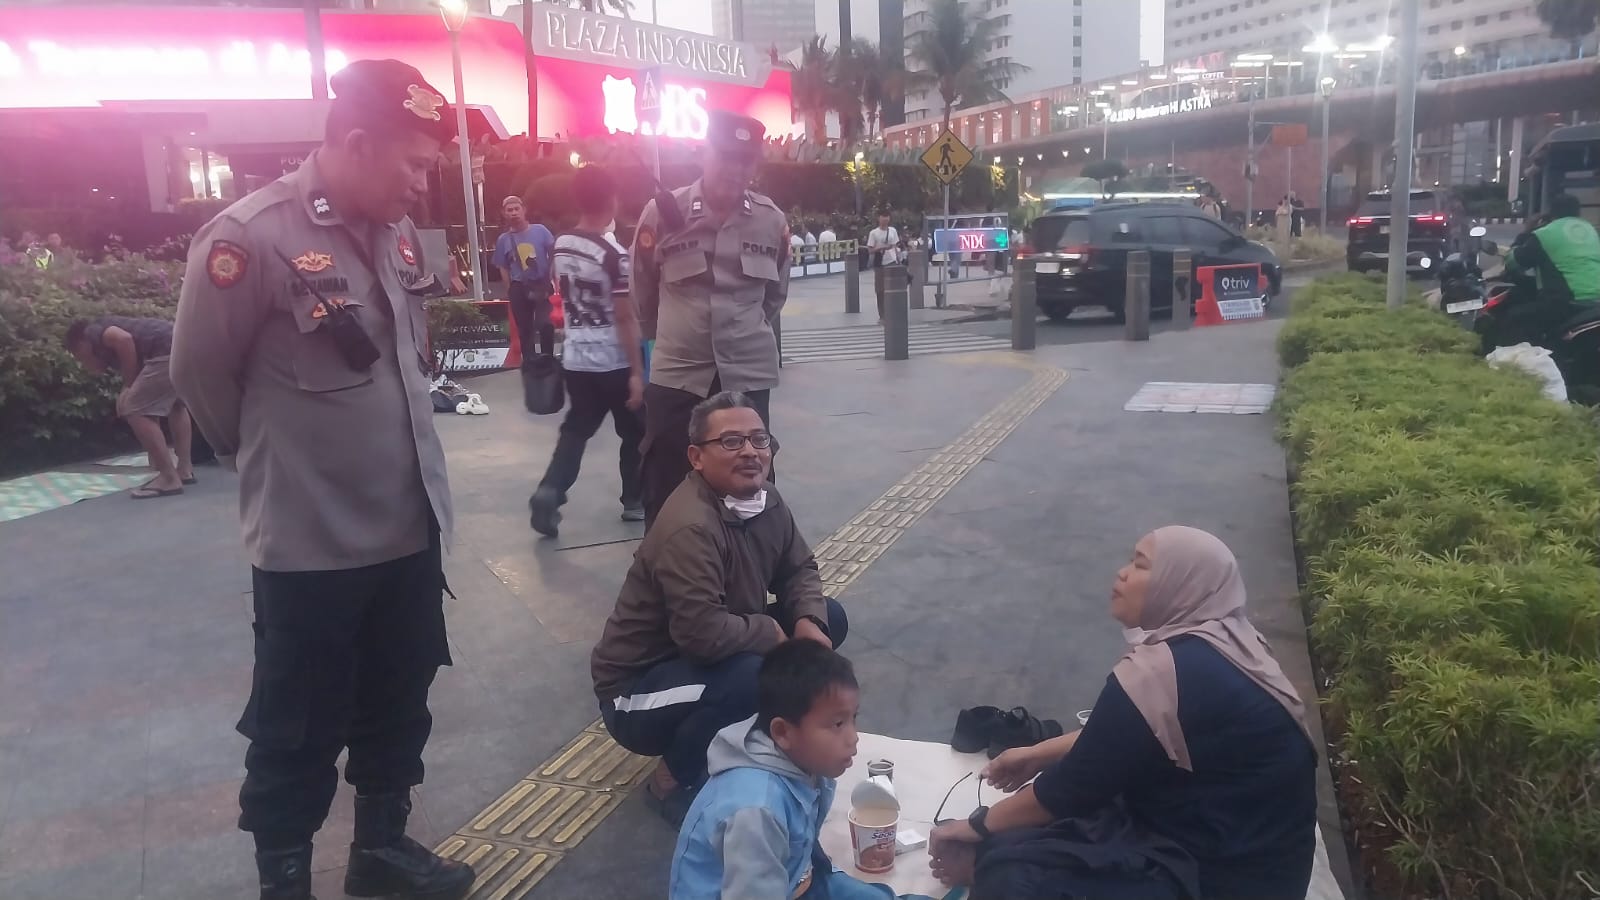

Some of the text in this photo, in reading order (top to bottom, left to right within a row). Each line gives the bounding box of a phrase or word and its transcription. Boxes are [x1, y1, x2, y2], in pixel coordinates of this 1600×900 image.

[546, 11, 747, 78] PLAZA INDONESIA
[1179, 96, 1212, 113] ASTRA
[1231, 275, 1250, 289] triv
